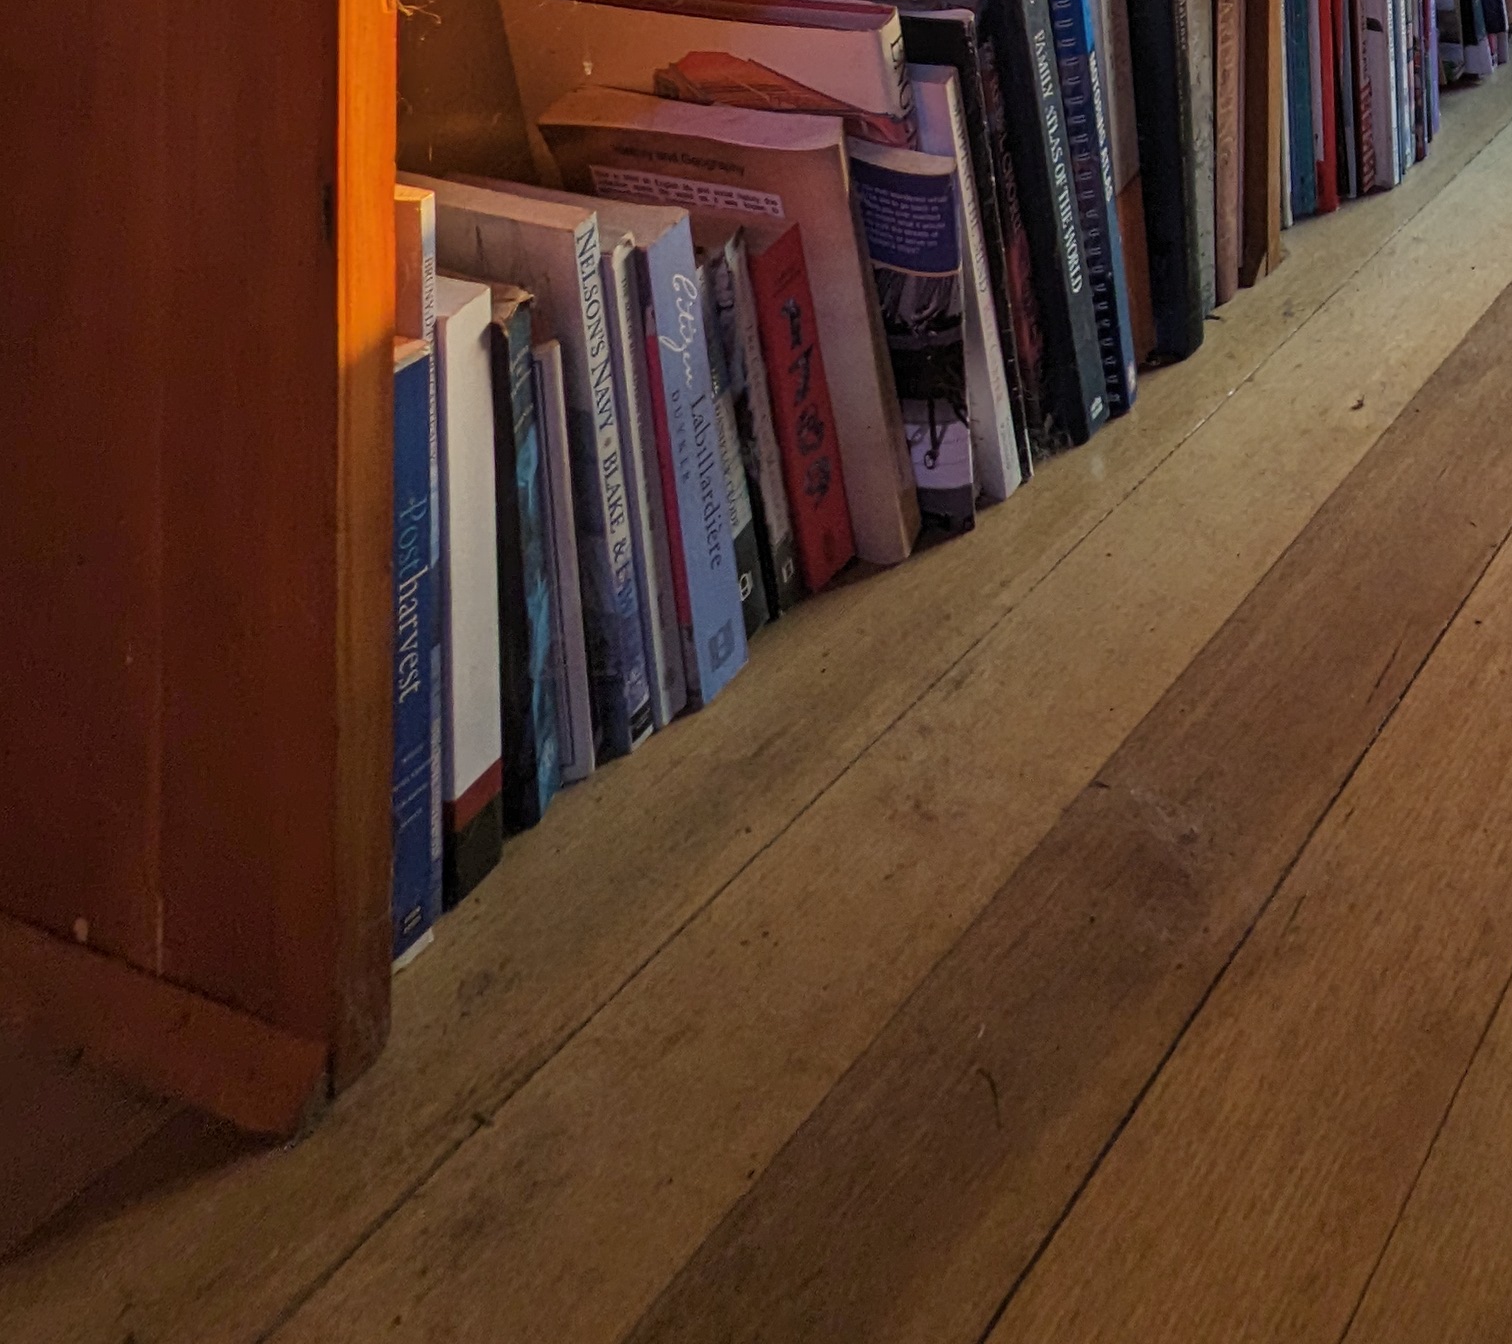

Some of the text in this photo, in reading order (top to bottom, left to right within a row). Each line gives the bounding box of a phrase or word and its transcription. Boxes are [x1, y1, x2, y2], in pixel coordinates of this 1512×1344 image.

[1033, 29, 1084, 294] FAMILY ATLAS OF THE WORLD
[1089, 51, 1114, 203] MOTORING ATLAS
[575, 226, 606, 358] NELSON'S
[659, 271, 699, 389] Citizen
[592, 356, 613, 430] NAVY
[601, 454, 626, 538] BLAKE
[688, 393, 725, 572] Labillardière
[397, 494, 430, 705] Postharvest
[615, 535, 627, 565] &
